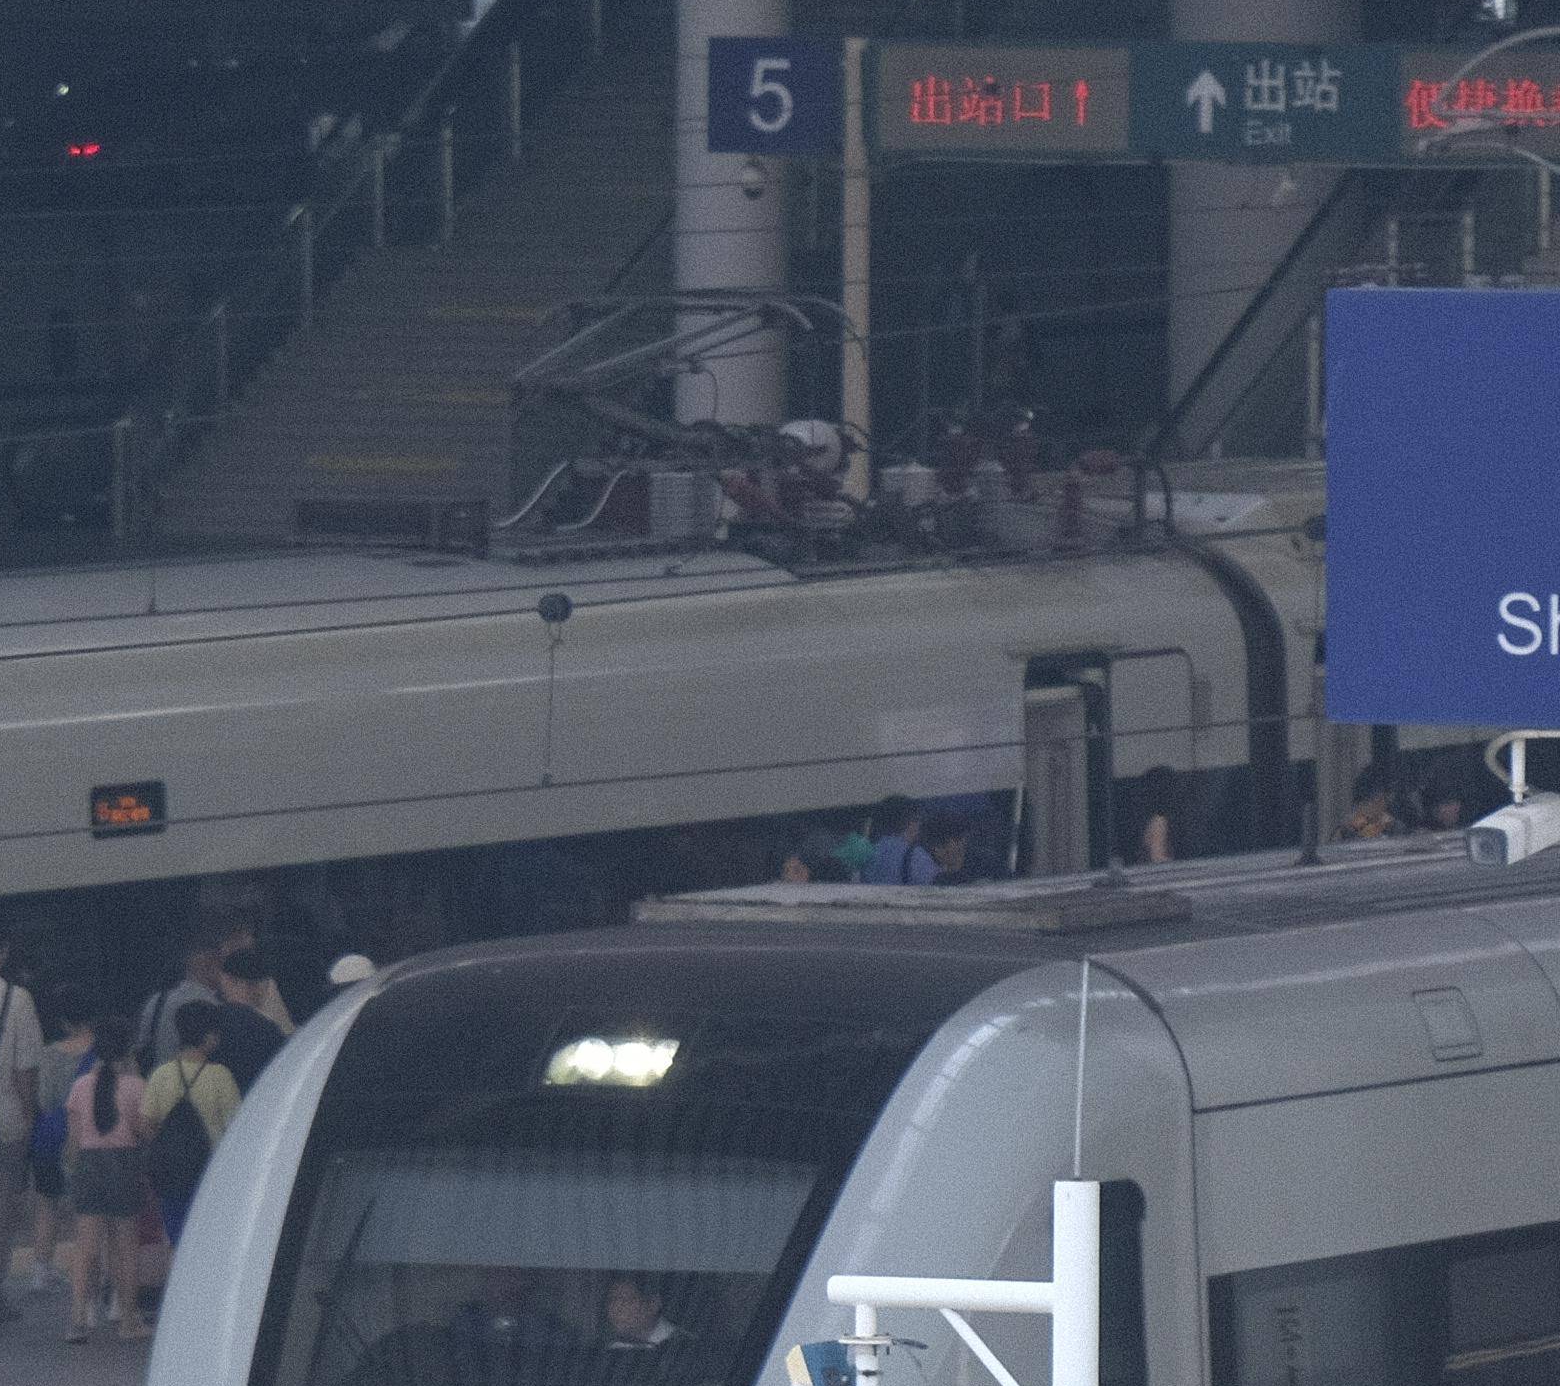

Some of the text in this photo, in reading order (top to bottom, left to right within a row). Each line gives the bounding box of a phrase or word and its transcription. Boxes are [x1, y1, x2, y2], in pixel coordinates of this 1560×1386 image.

[747, 57, 794, 134] 5
[908, 76, 1052, 126] 出站口
[1242, 58, 1342, 115] 出站
[1245, 120, 1292, 146] Exit
